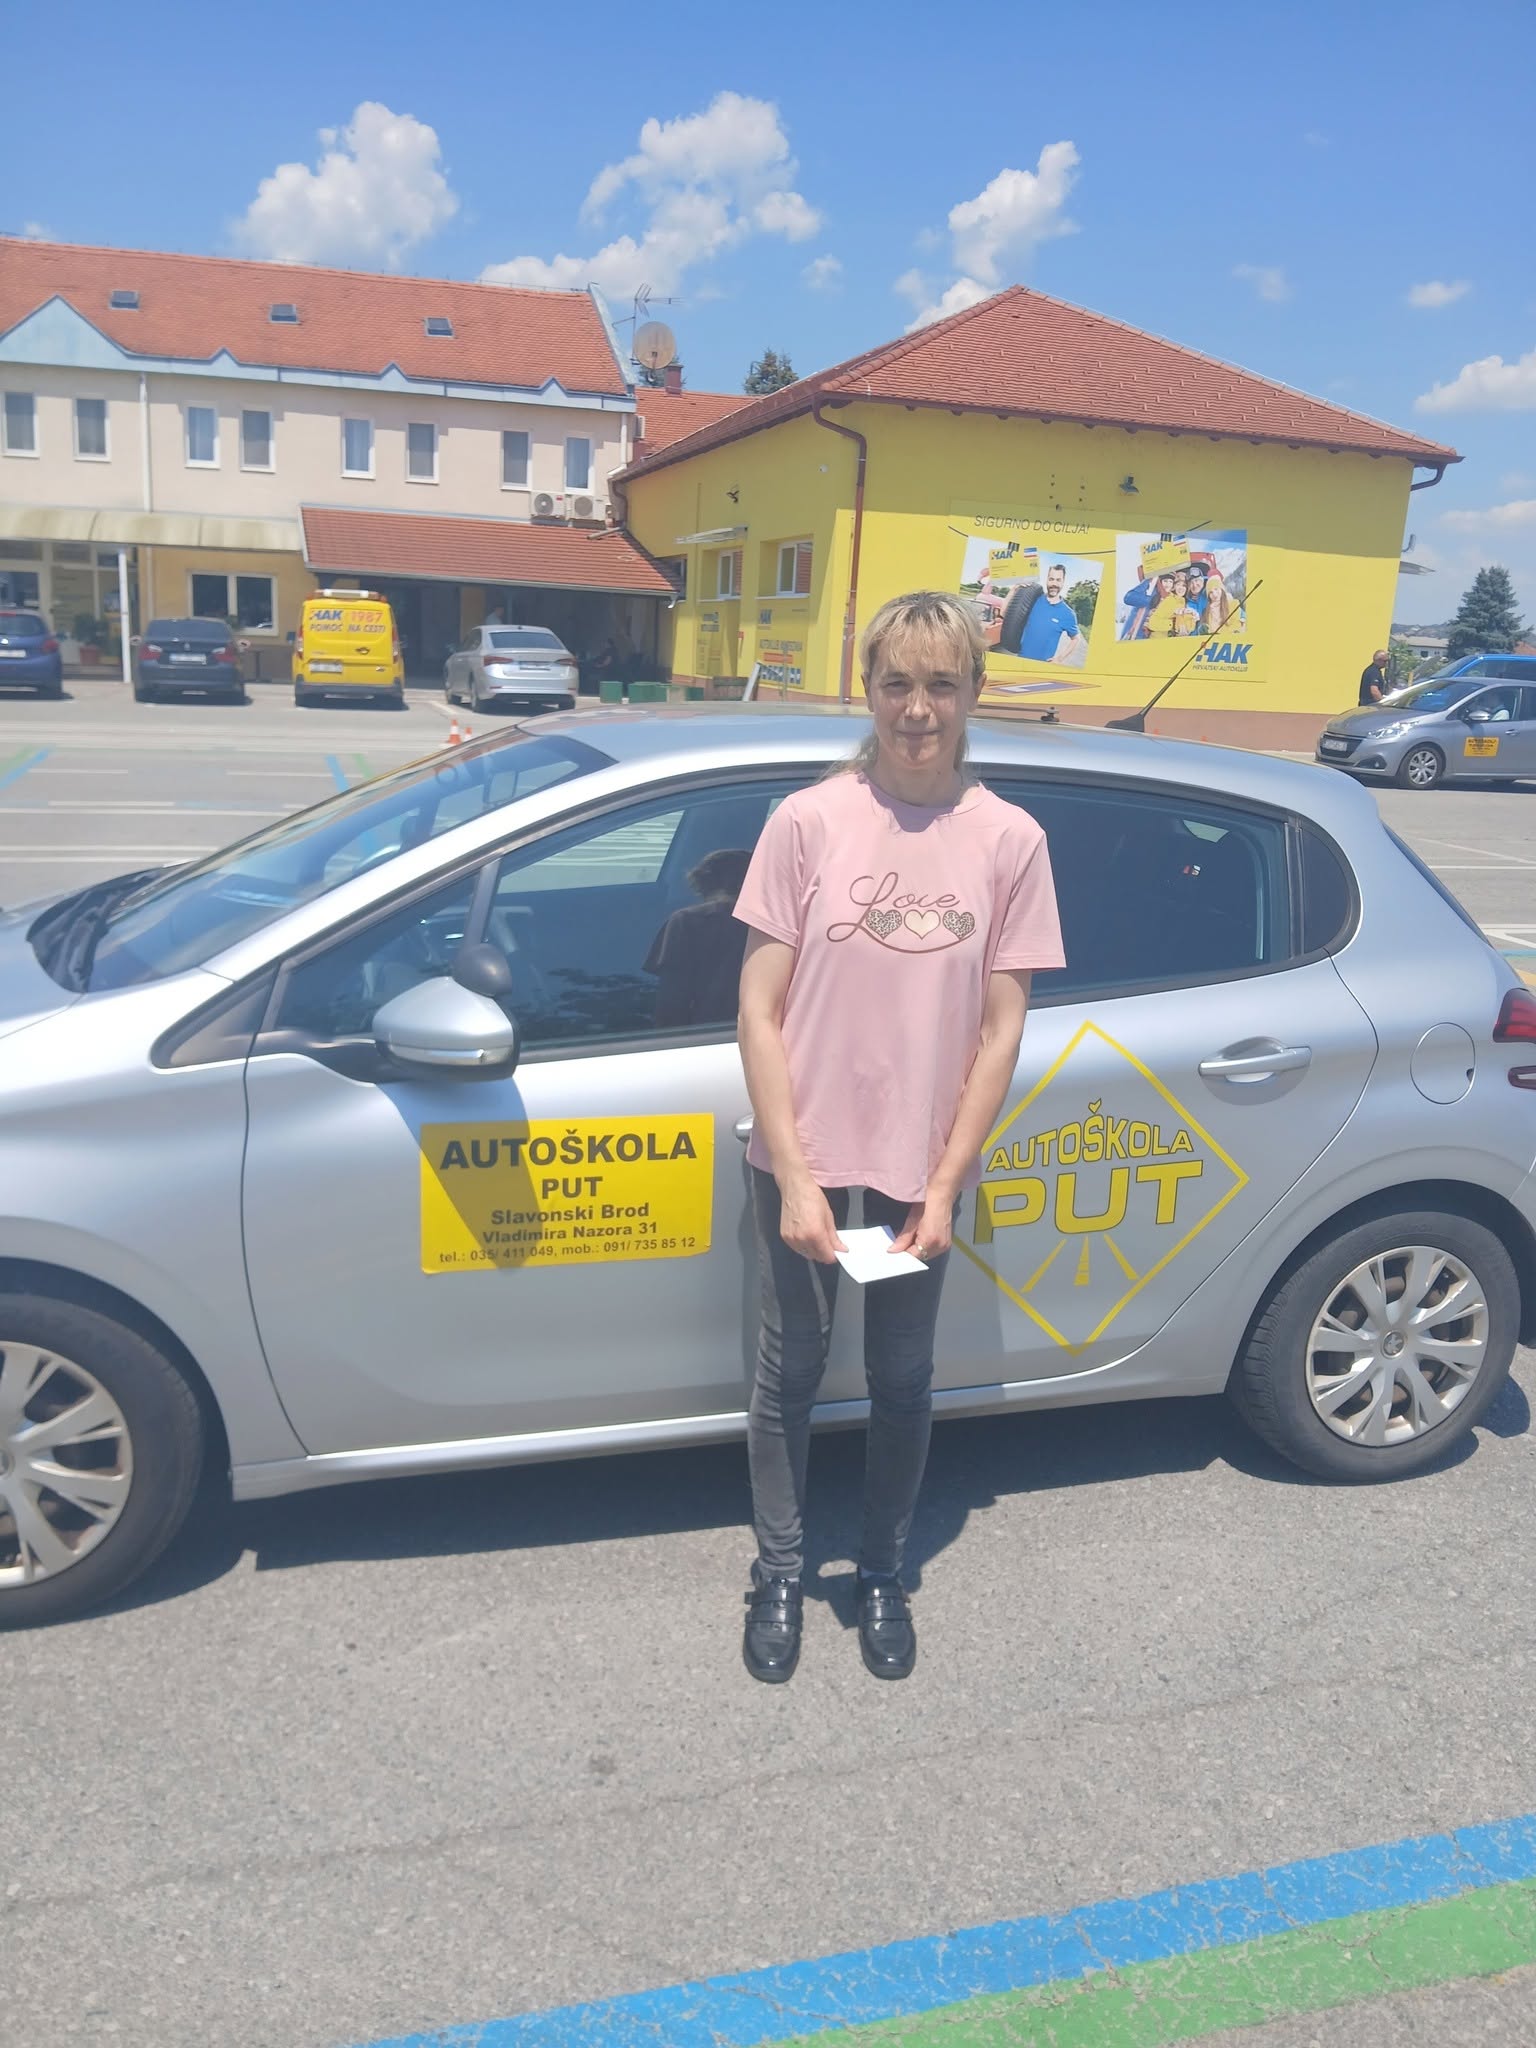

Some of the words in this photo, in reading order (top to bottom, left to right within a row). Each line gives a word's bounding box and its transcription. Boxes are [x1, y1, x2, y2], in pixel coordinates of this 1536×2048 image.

[974, 515, 1031, 531] SIGURNO
[1033, 519, 1052, 532] DO
[1053, 521, 1090, 534] CILJA!
[991, 550, 1014, 560] HAK
[1143, 542, 1163, 554] HAK
[351, 610, 384, 622] 1987
[348, 624, 360, 632] NA
[363, 624, 386, 633] CESTI
[1195, 642, 1253, 664] HAK
[827, 872, 970, 948] Love
[986, 1098, 1195, 1173] AUTOŠKOLA
[440, 1129, 697, 1170] AUTOŠKOLA
[541, 1176, 603, 1200] PUT
[491, 1205, 594, 1225] Slavonski
[601, 1203, 649, 1219] Brod
[972, 1160, 1204, 1246] PUT
[482, 1228, 567, 1244] Vladimira
[573, 1225, 632, 1239] Nazora
[639, 1222, 657, 1234] 31
[440, 1251, 465, 1263] tel.:
[470, 1249, 499, 1261] 035/
[503, 1247, 525, 1259] 411
[530, 1246, 557, 1257] 049,
[562, 1244, 599, 1255] mob.:
[603, 1240, 630, 1253] 091/
[634, 1239, 657, 1250] 735
[661, 1238, 676, 1249] 85
[680, 1237, 696, 1248] 12
